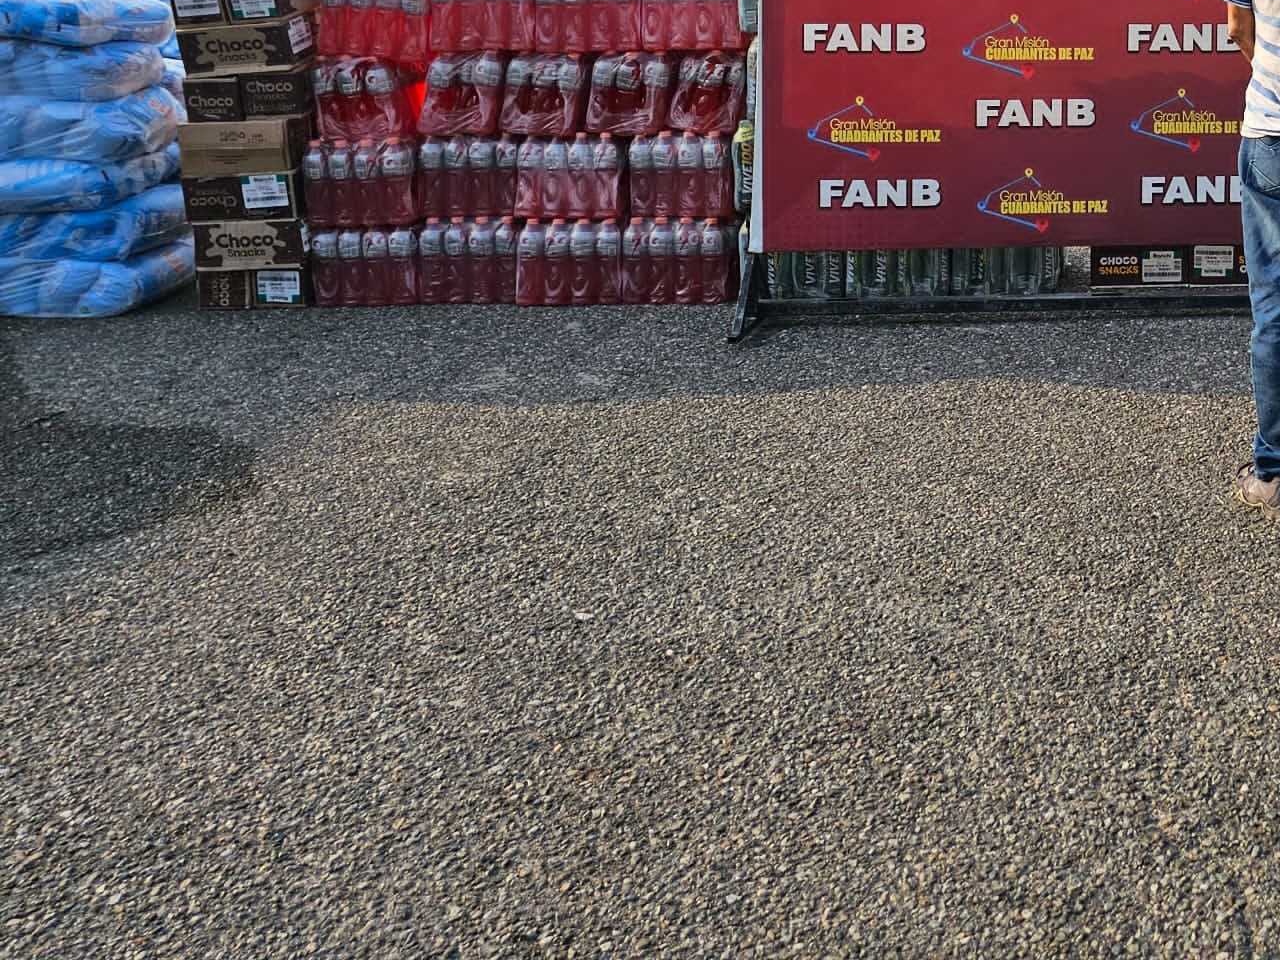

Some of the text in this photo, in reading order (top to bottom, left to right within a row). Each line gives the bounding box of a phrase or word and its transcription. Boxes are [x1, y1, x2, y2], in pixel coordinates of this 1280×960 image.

[802, 23, 927, 53] FANB
[984, 36, 1050, 48] Gran Misión
[205, 39, 264, 54] Choco
[985, 47, 1094, 61] CUADRANTES DE PAZ
[246, 80, 293, 93] Choco
[188, 95, 234, 107] Choco
[975, 98, 1096, 129] FANB
[830, 118, 896, 130] Gran Misión
[830, 129, 941, 143] CUADRANTES DE PAZ
[819, 178, 942, 209] FANB
[1000, 190, 1064, 203] Gran Misión
[1000, 200, 1108, 214] CUADRANTES DE PAZ
[216, 234, 274, 249] Choco
[227, 248, 266, 257] Snacks
[1100, 256, 1138, 265] CHOCO
[1099, 266, 1139, 275] SNACKS
